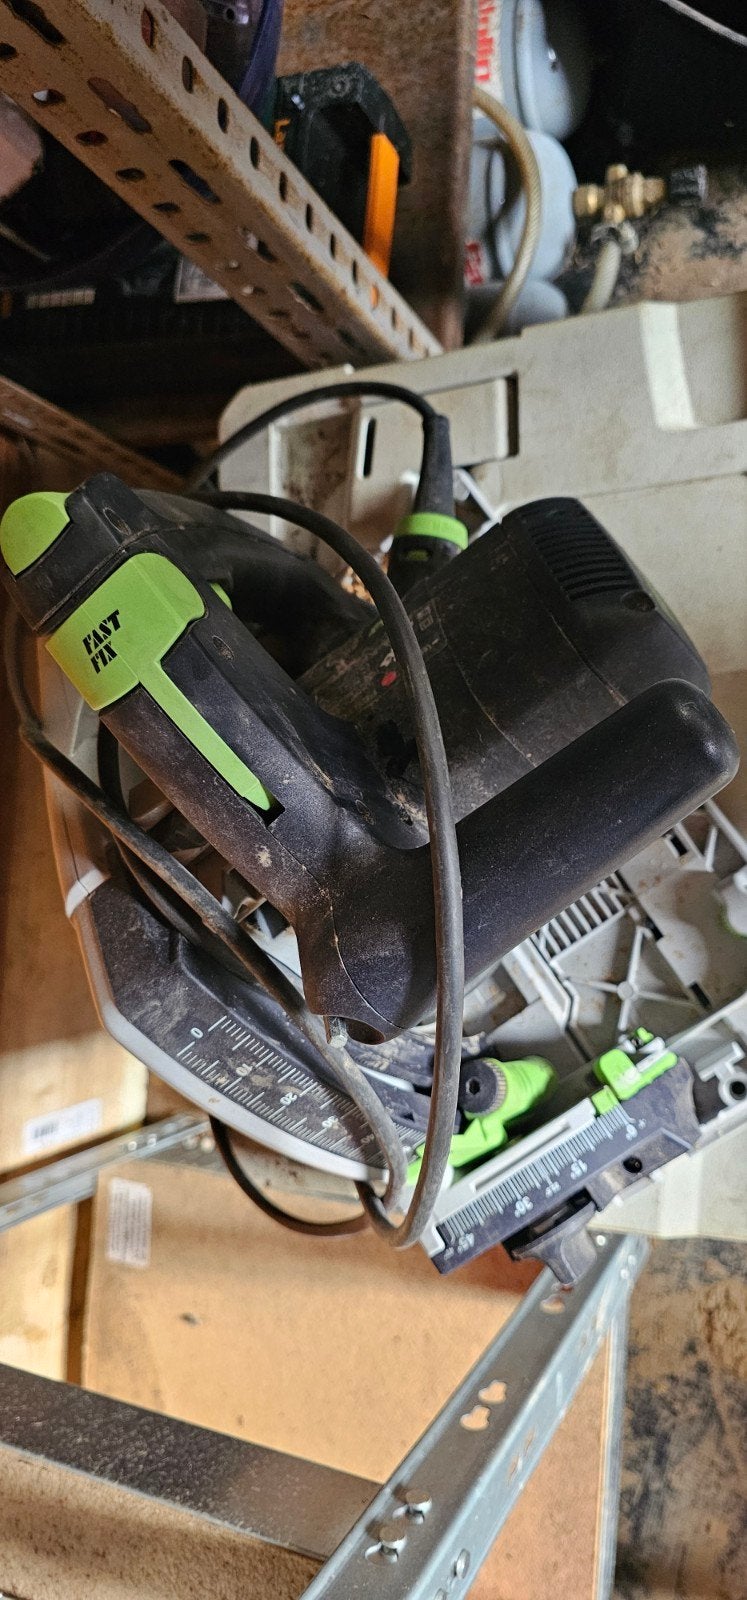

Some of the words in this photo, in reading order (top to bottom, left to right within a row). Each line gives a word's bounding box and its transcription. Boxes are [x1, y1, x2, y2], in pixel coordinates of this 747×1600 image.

[83, 609, 121, 656] FAST
[91, 640, 118, 674] FIX
[190, 1027, 204, 1039] 0
[236, 1063, 253, 1077] 10
[280, 1092, 297, 1106] 20
